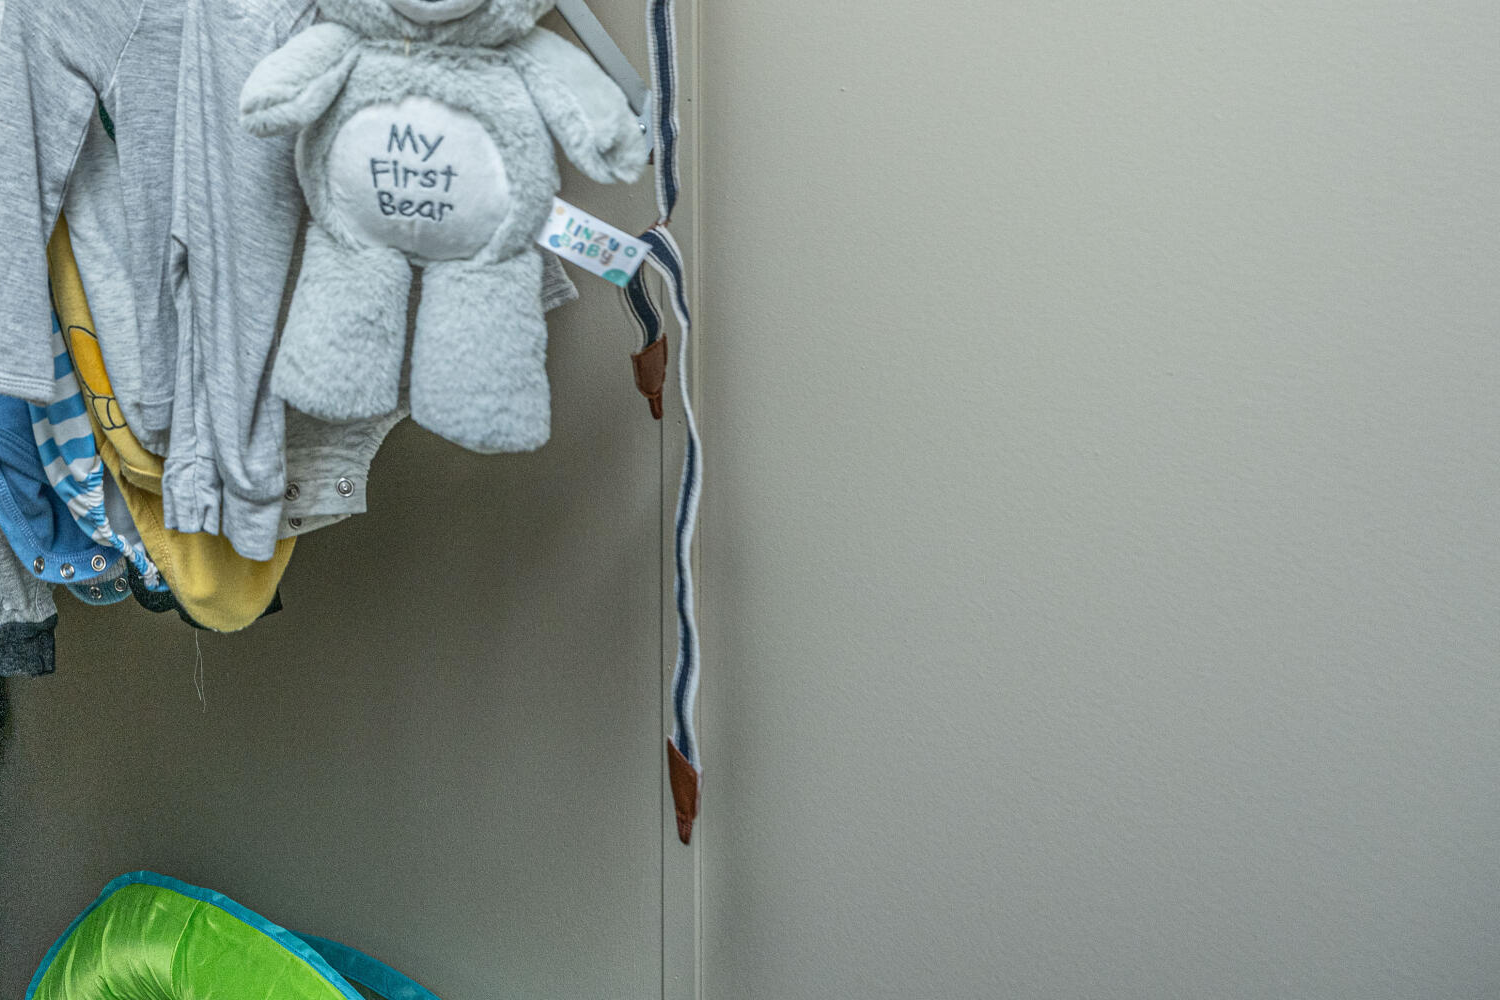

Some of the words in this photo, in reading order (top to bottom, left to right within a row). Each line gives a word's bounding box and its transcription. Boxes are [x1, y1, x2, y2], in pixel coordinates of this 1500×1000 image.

[387, 123, 444, 162] My
[370, 157, 459, 192] First
[376, 191, 454, 223] Bear
[559, 231, 613, 266] BABY
